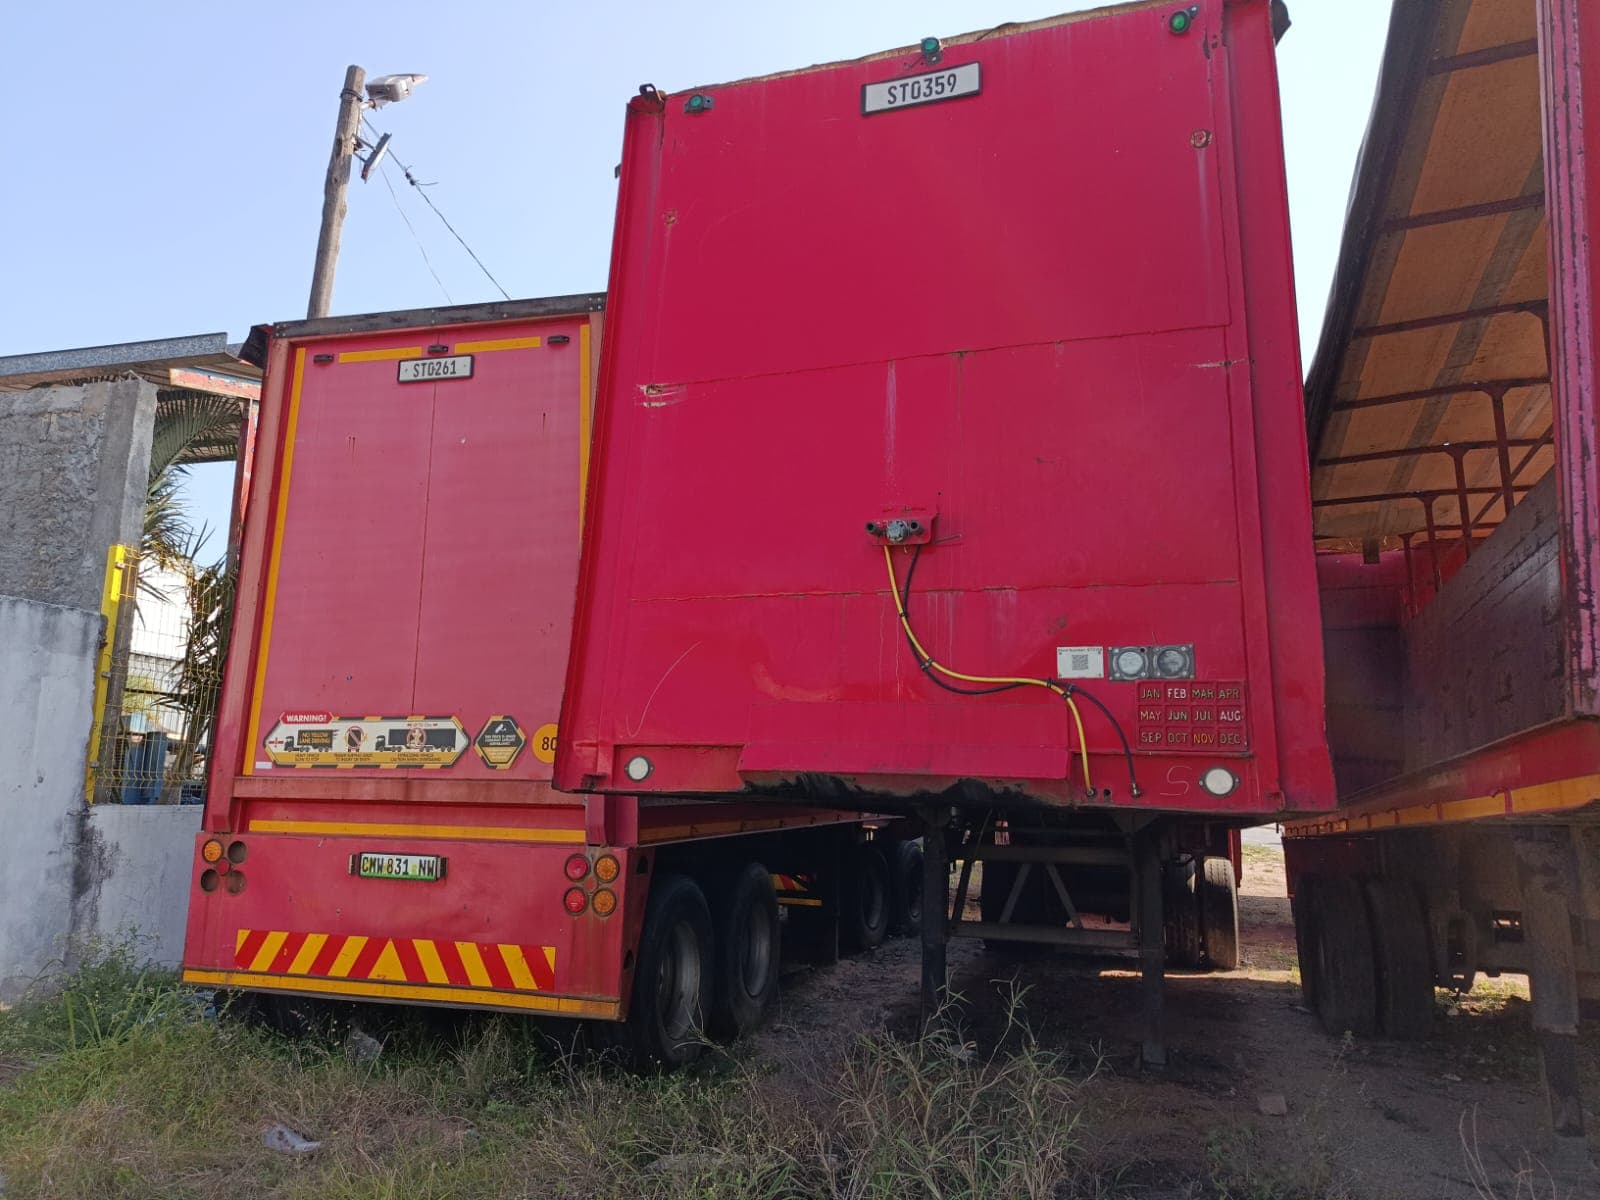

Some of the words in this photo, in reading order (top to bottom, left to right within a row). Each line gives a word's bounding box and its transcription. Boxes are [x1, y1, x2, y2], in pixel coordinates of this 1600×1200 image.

[1141, 689, 1160, 698] JAN
[1167, 688, 1187, 699] FEB
[1192, 688, 1214, 698] MAR
[1219, 688, 1240, 699] APR
[286, 714, 328, 723] WARNING!
[1140, 711, 1161, 721] MAY
[1168, 711, 1188, 721] JUN
[1194, 711, 1213, 721] JUL
[1220, 710, 1241, 721] AUG
[1141, 733, 1162, 743] SEP
[1168, 733, 1188, 744] OCT
[1193, 733, 1215, 744] NOV
[1220, 733, 1241, 744] DEC
[386, 858, 409, 875] 831
